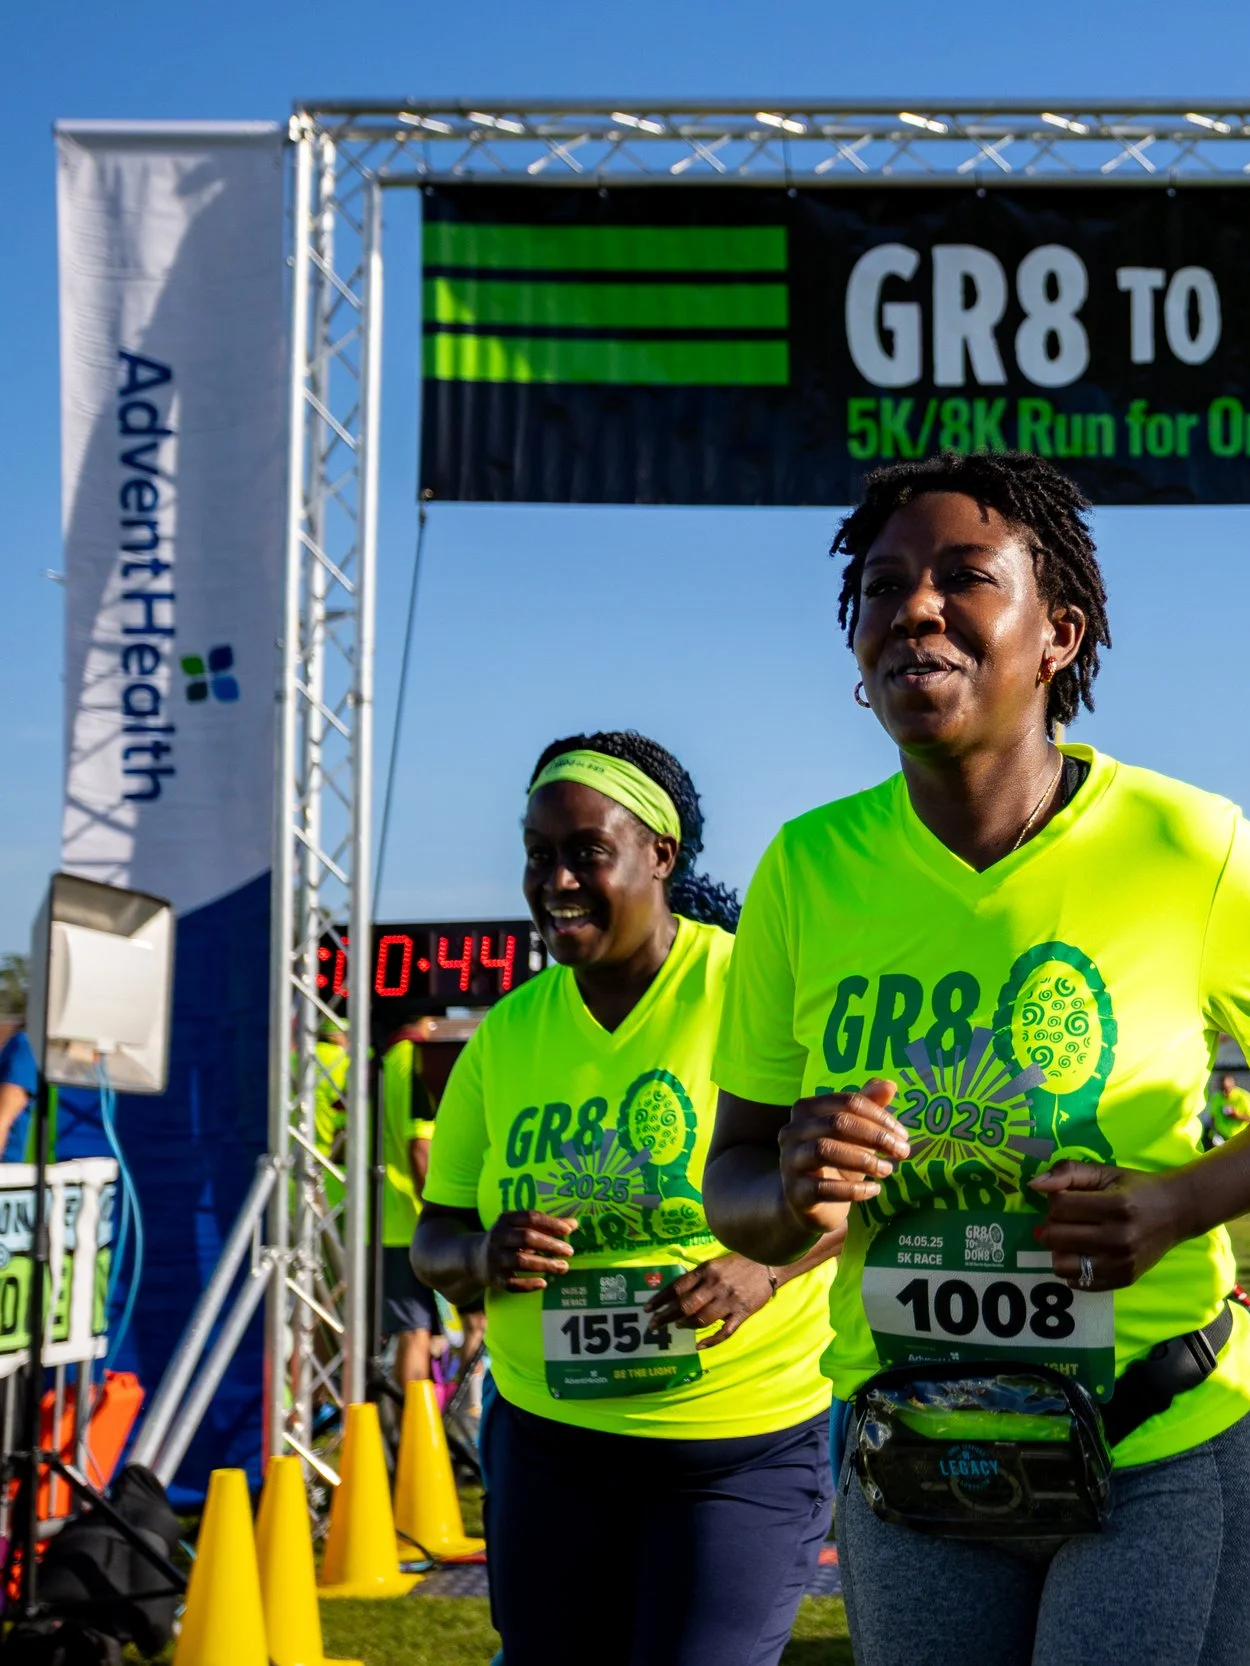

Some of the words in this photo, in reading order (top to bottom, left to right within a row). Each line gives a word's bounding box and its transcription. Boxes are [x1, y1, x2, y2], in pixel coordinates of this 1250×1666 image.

[845, 243, 1090, 388] GR8
[1116, 266, 1222, 365] TO
[847, 398, 1008, 459] 5K/8K
[1017, 398, 1115, 457] Run
[1126, 398, 1199, 457] for
[117, 350, 177, 802] AdventHealth
[823, 971, 980, 1073] GR8
[506, 1096, 608, 1168] GR8
[898, 1089, 1008, 1148] 2025
[499, 1173, 537, 1212] TO
[557, 1171, 630, 1204] 2025
[898, 1235, 944, 1248] 04.05.25
[965, 1225, 987, 1239] GR8
[965, 1239, 976, 1249] TO
[897, 1253, 912, 1264] 5K
[914, 1253, 943, 1265] RACE
[964, 1249, 991, 1262] DON8
[895, 1278, 1076, 1339] 1008
[561, 1313, 672, 1355] 1554
[940, 1459, 998, 1476] LEGACY
